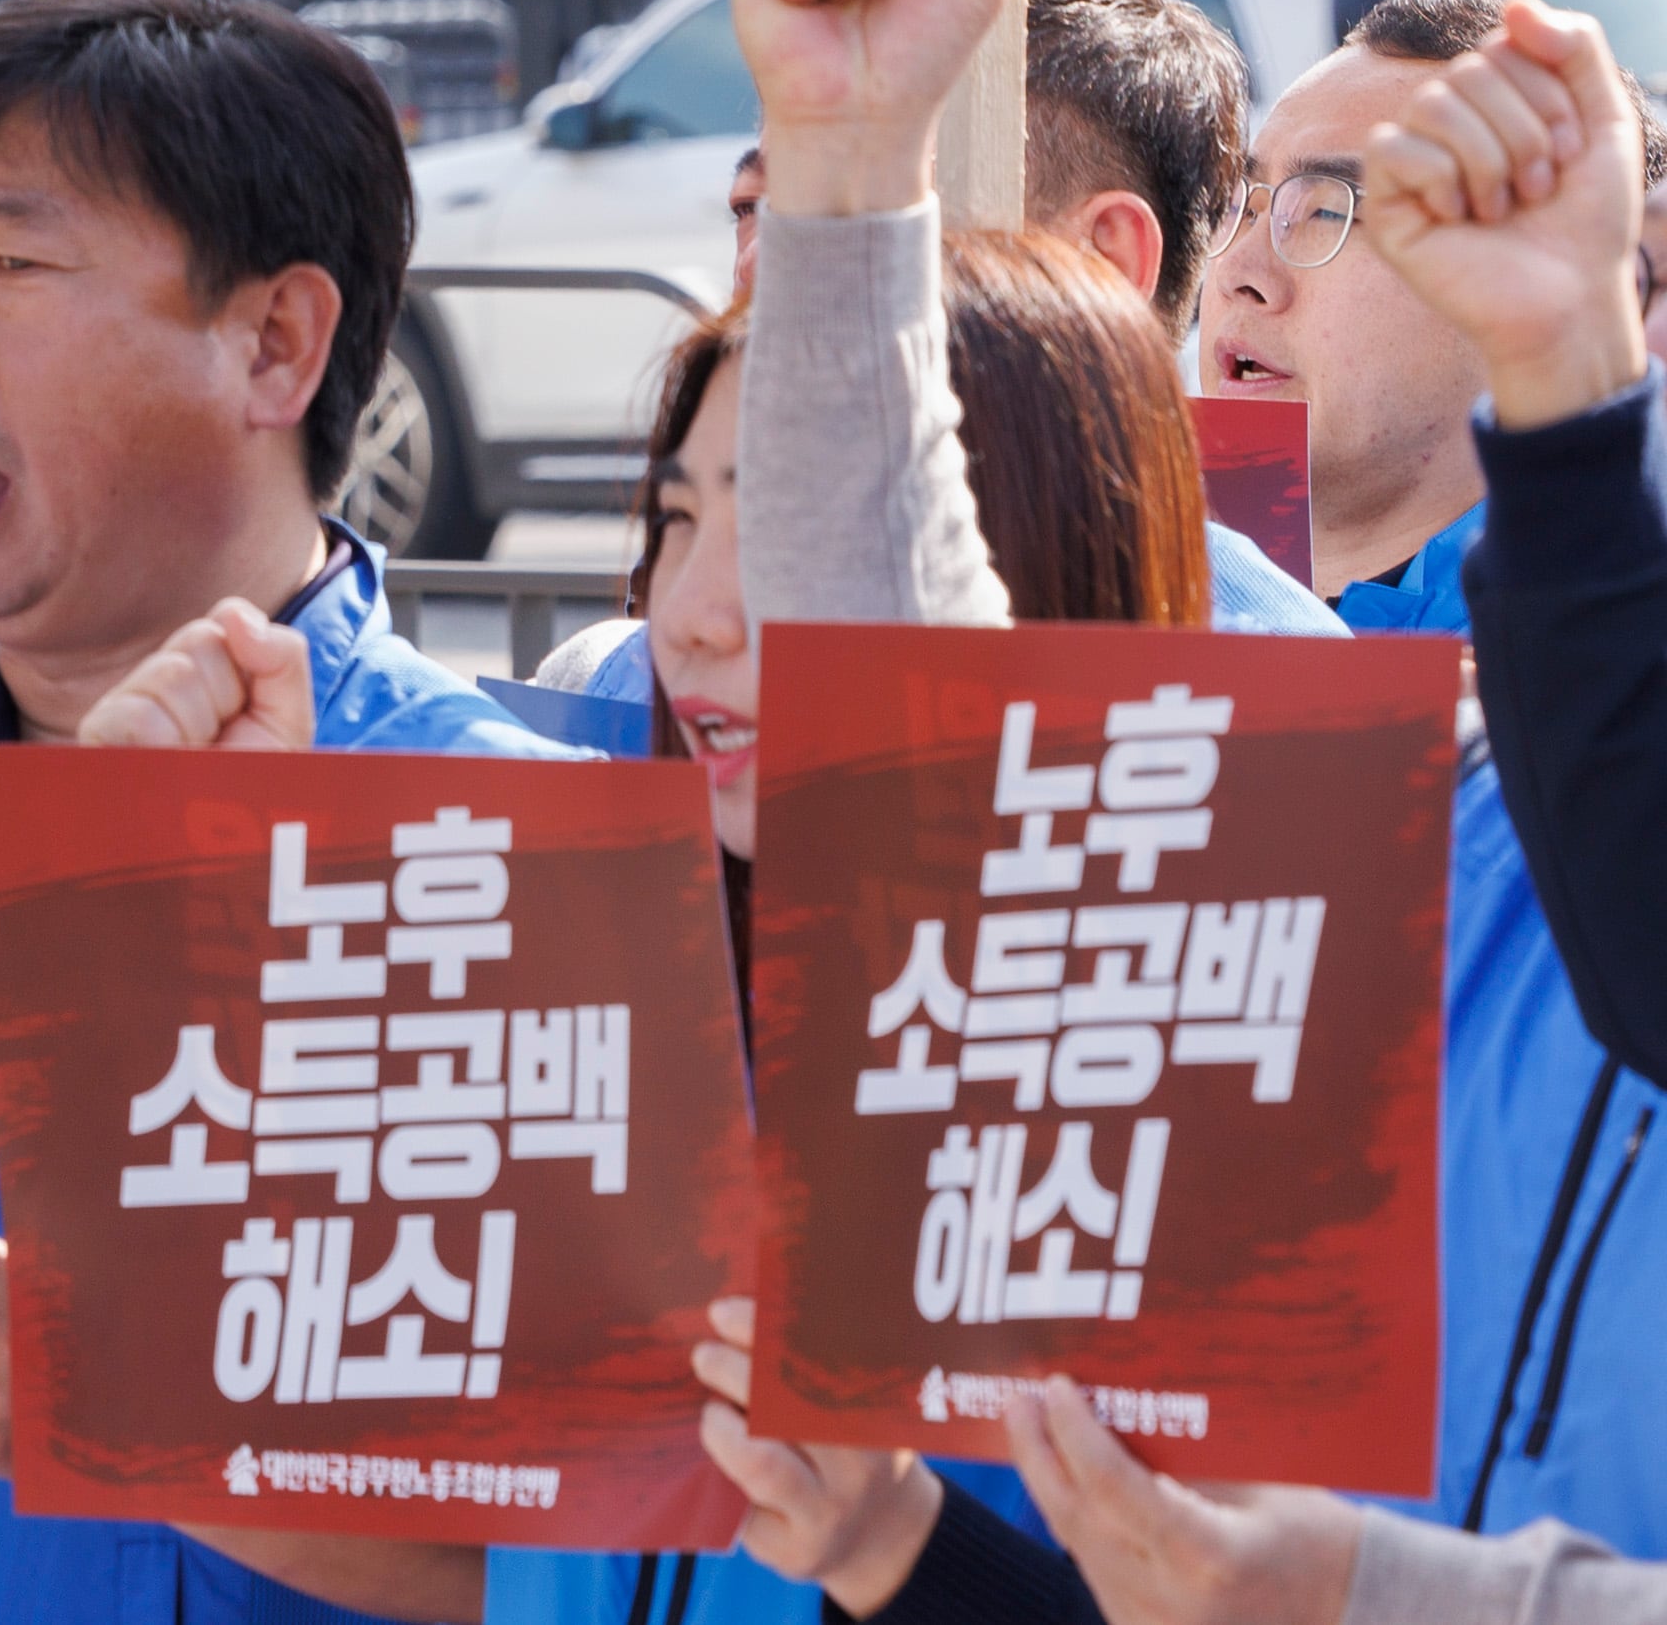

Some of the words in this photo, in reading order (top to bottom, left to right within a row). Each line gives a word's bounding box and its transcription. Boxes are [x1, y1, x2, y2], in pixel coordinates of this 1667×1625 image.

[981, 684, 1233, 896] 노후
[261, 807, 512, 1002] 노후
[855, 896, 1325, 1115] 소득공백
[120, 1004, 630, 1208] 소득공백
[214, 1211, 516, 1403] 해소!
[915, 1118, 1170, 1323] 해소!
